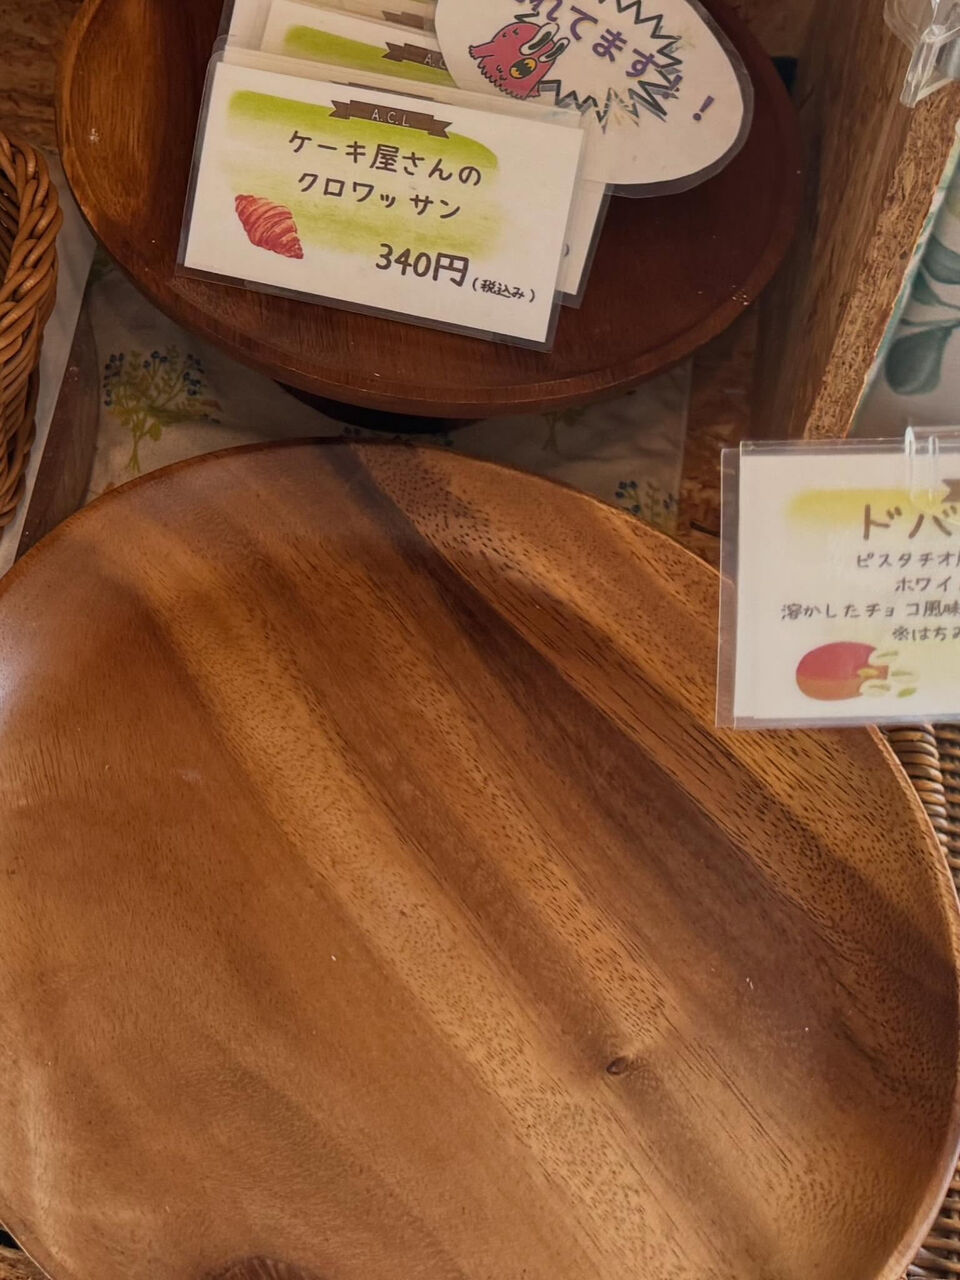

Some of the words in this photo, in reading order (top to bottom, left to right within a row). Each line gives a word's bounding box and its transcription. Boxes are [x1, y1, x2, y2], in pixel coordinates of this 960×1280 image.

[287, 130, 483, 188] ケーキ屋さんの
[297, 173, 463, 220] クロワッサン
[375, 242, 471, 289] 340円
[856, 552, 960, 568] ピスタチオ
[895, 576, 960, 592] ホワイ
